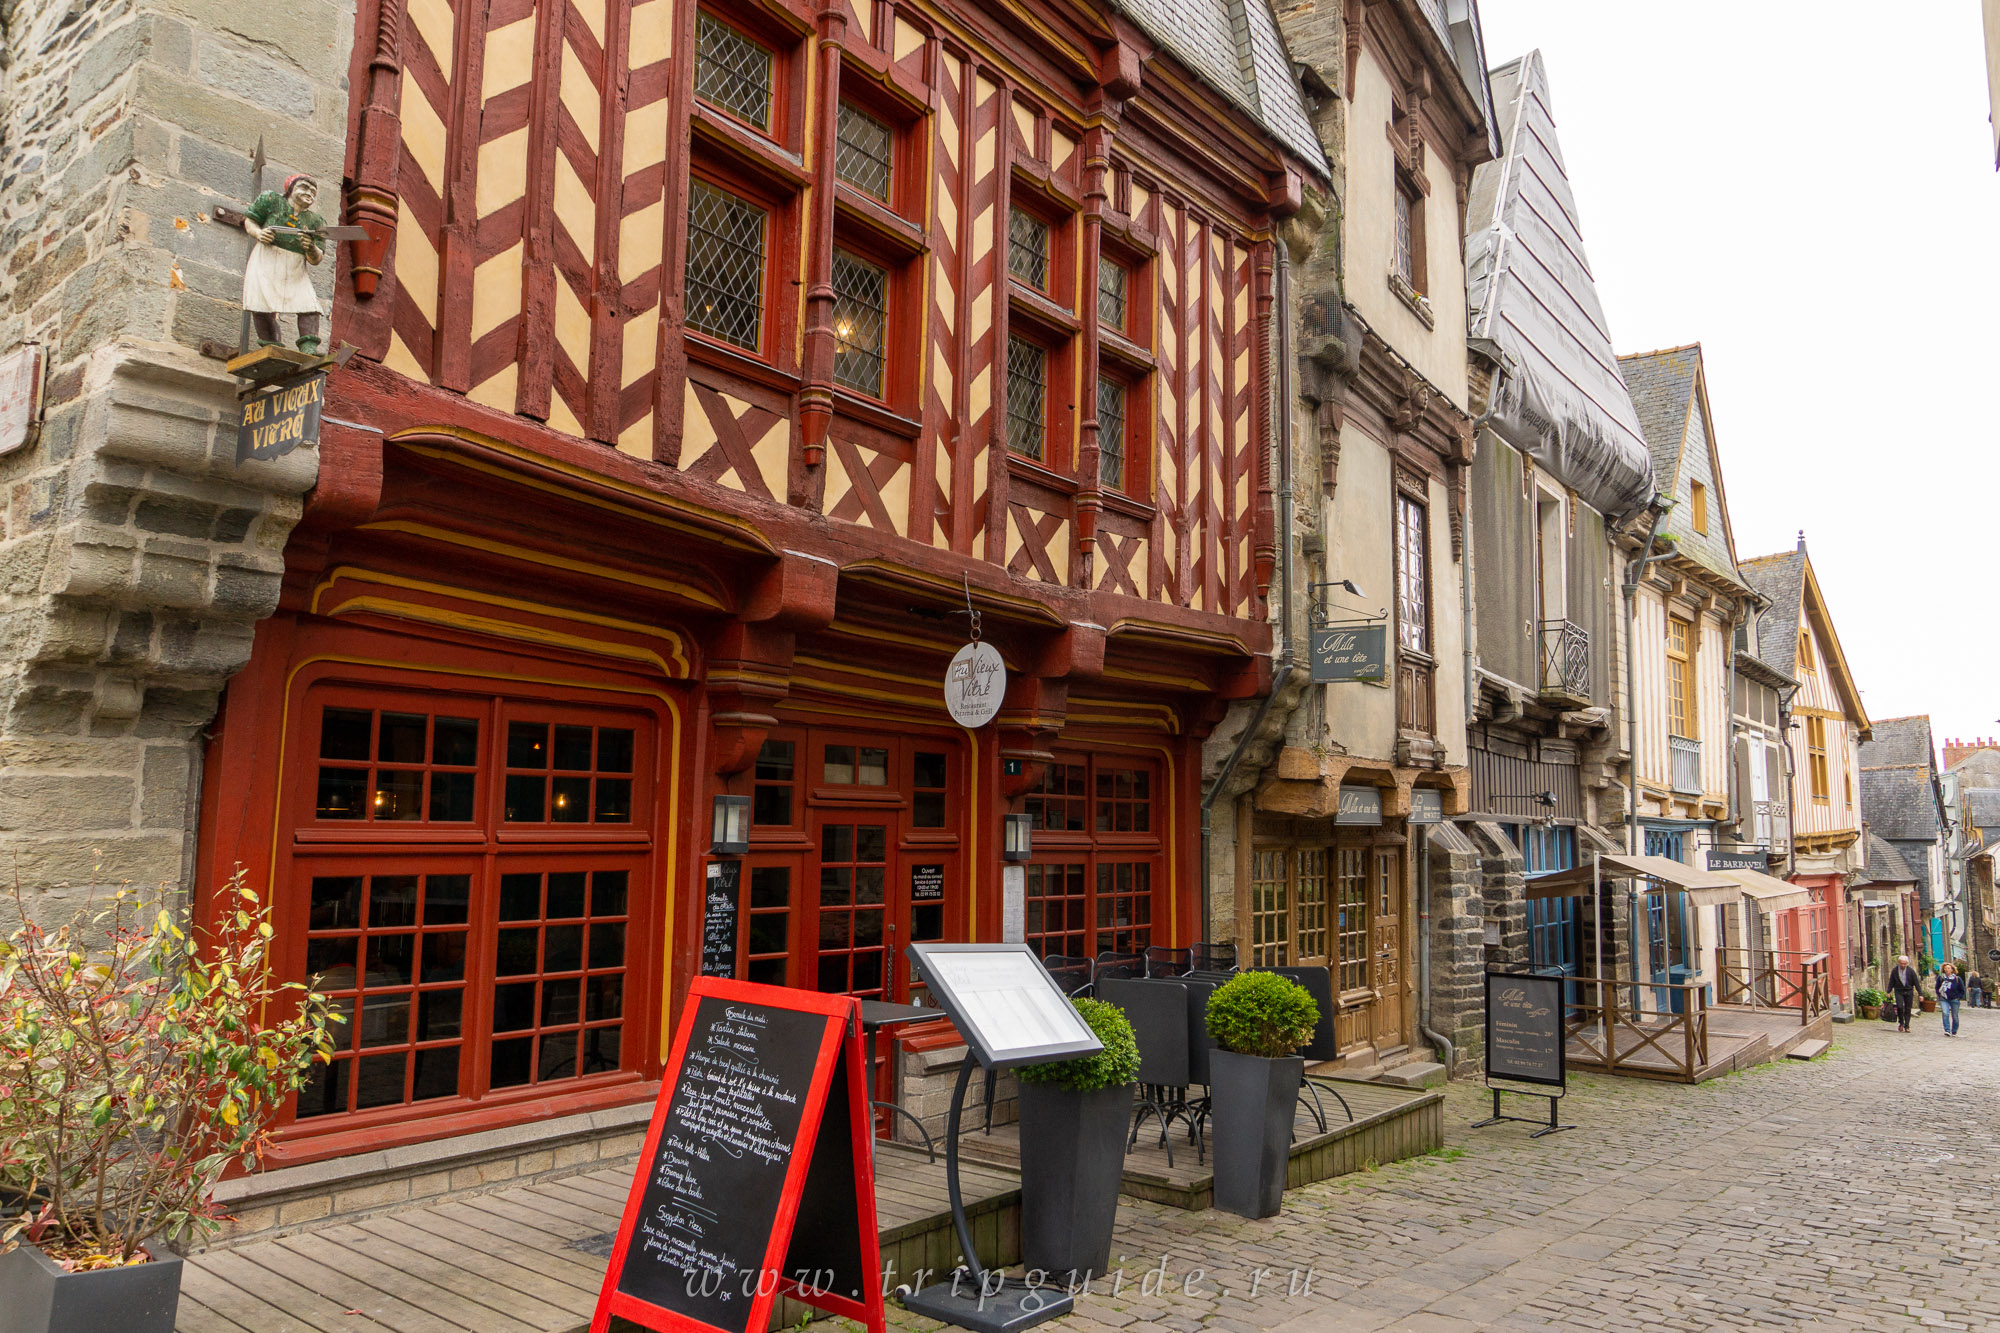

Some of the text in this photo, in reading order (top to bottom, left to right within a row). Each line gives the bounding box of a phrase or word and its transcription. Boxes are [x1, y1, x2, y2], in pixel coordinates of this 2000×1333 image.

[242, 399, 266, 427] AU
[1317, 632, 1357, 654] Mille
[1323, 651, 1368, 664] et une tête
[955, 654, 1000, 680] Au Vieux
[962, 676, 991, 701] Vitré
[960, 702, 987, 710] Restaurant
[954, 709, 974, 717] Pizzeria
[1009, 762, 1014, 773] 1
[1338, 792, 1359, 816] Mille
[1358, 804, 1364, 813] et
[1709, 859, 1765, 869] LE BARRAVEL
[1497, 987, 1526, 1001] Mille
[713, 1034, 731, 1047] Salade
[1495, 1036, 1520, 1045] Masculin
